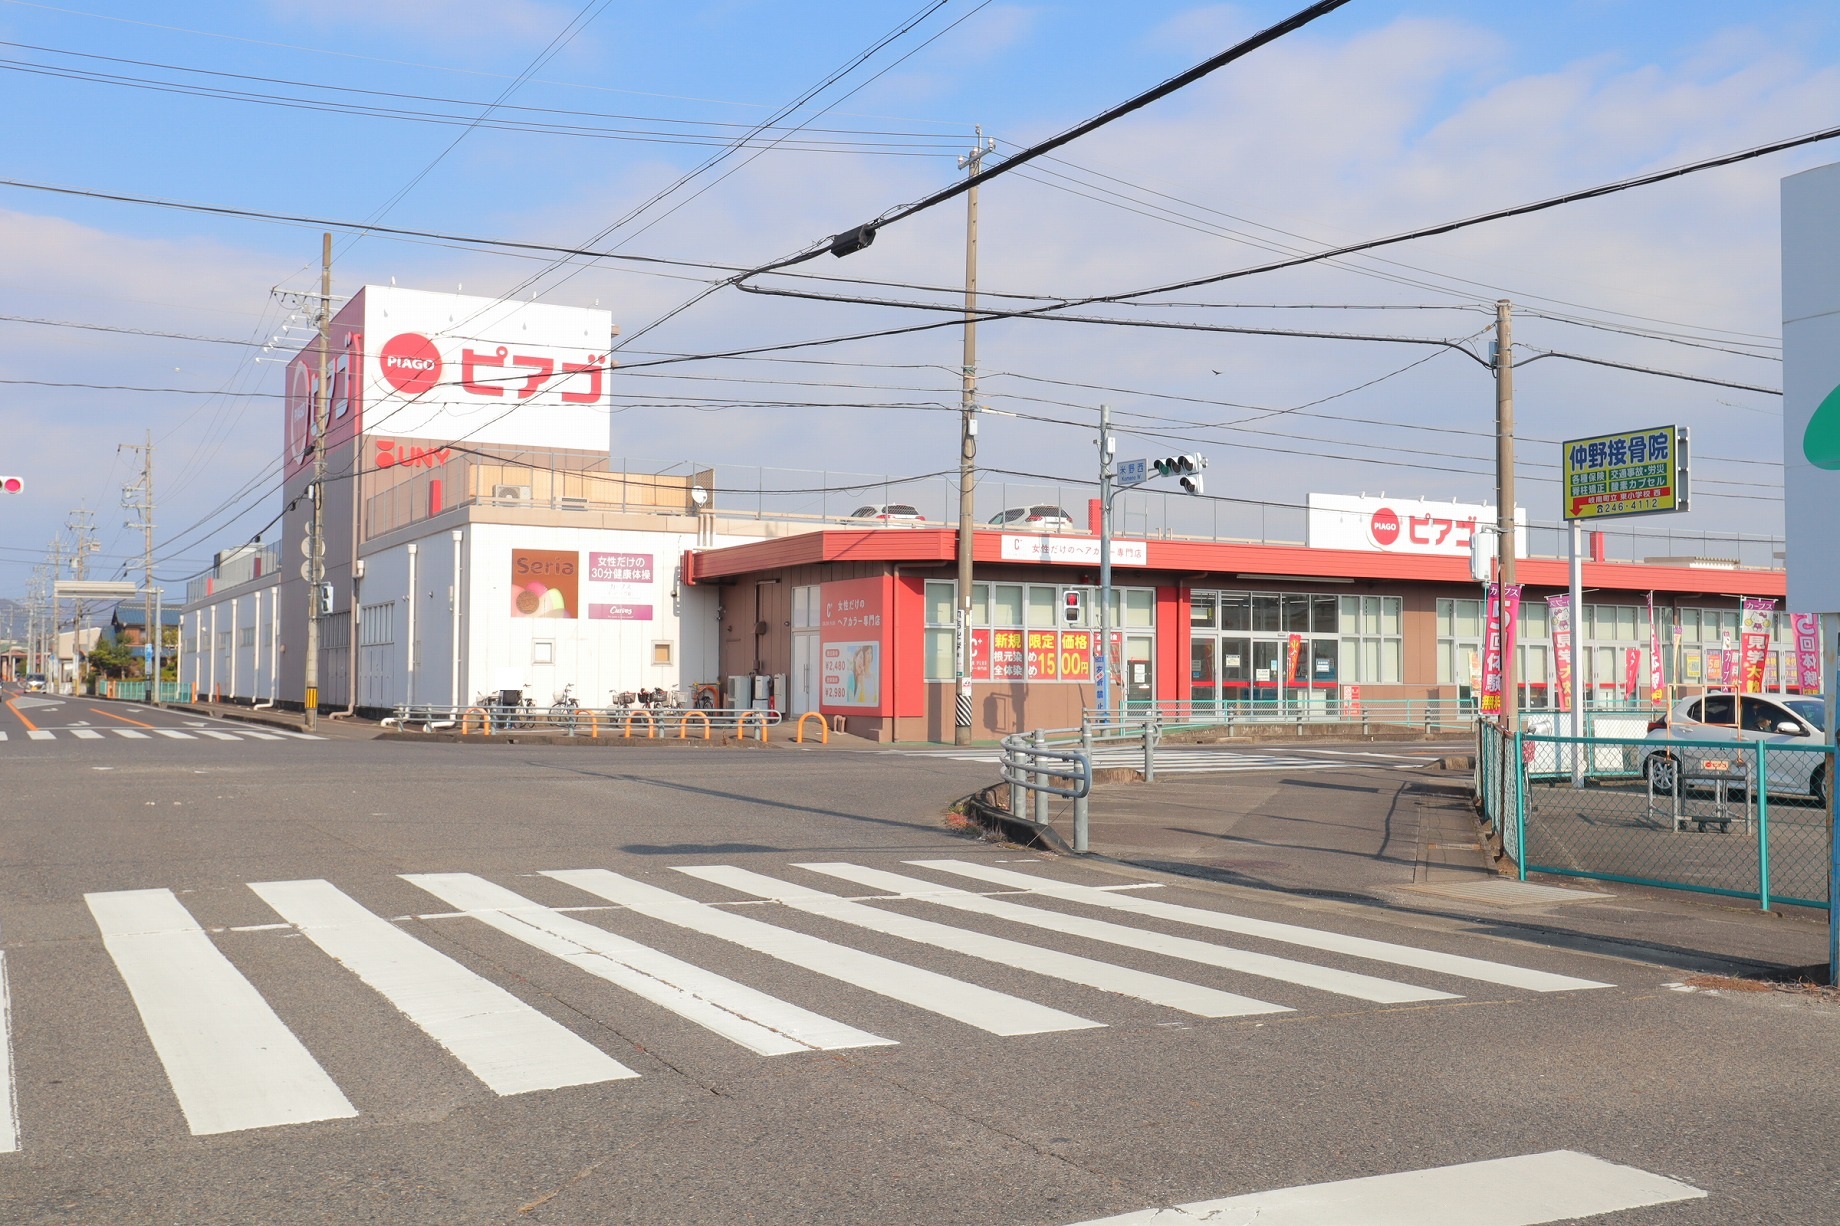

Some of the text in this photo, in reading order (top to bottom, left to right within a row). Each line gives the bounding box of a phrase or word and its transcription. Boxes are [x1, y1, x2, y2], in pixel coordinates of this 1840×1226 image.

[387, 355, 435, 371] PIAGO
[461, 346, 606, 404] ピアゴ
[398, 445, 450, 469] UNY
[1569, 432, 1668, 472] 仲野接骨院
[1572, 471, 1605, 485] 各種保険
[1610, 476, 1665, 492] 酸素カプセル
[1374, 522, 1397, 531] PIAGO
[1409, 512, 1477, 547] ピアゴ
[1032, 543, 1142, 559] 女性だけのヘアカー専門店
[517, 557, 574, 575] Seria
[597, 555, 645, 567] 女性だけの
[591, 568, 651, 580] 30分健康体操
[1489, 586, 1519, 597] カブス
[609, 606, 633, 616] Curves
[837, 599, 865, 612] 女性だけの
[837, 614, 881, 627] ヘアカラー専門店
[994, 651, 1037, 662] 根元染め
[825, 660, 846, 672] ¥2,480
[994, 665, 1038, 677] 全体染め
[825, 687, 846, 699] ¥2,980
